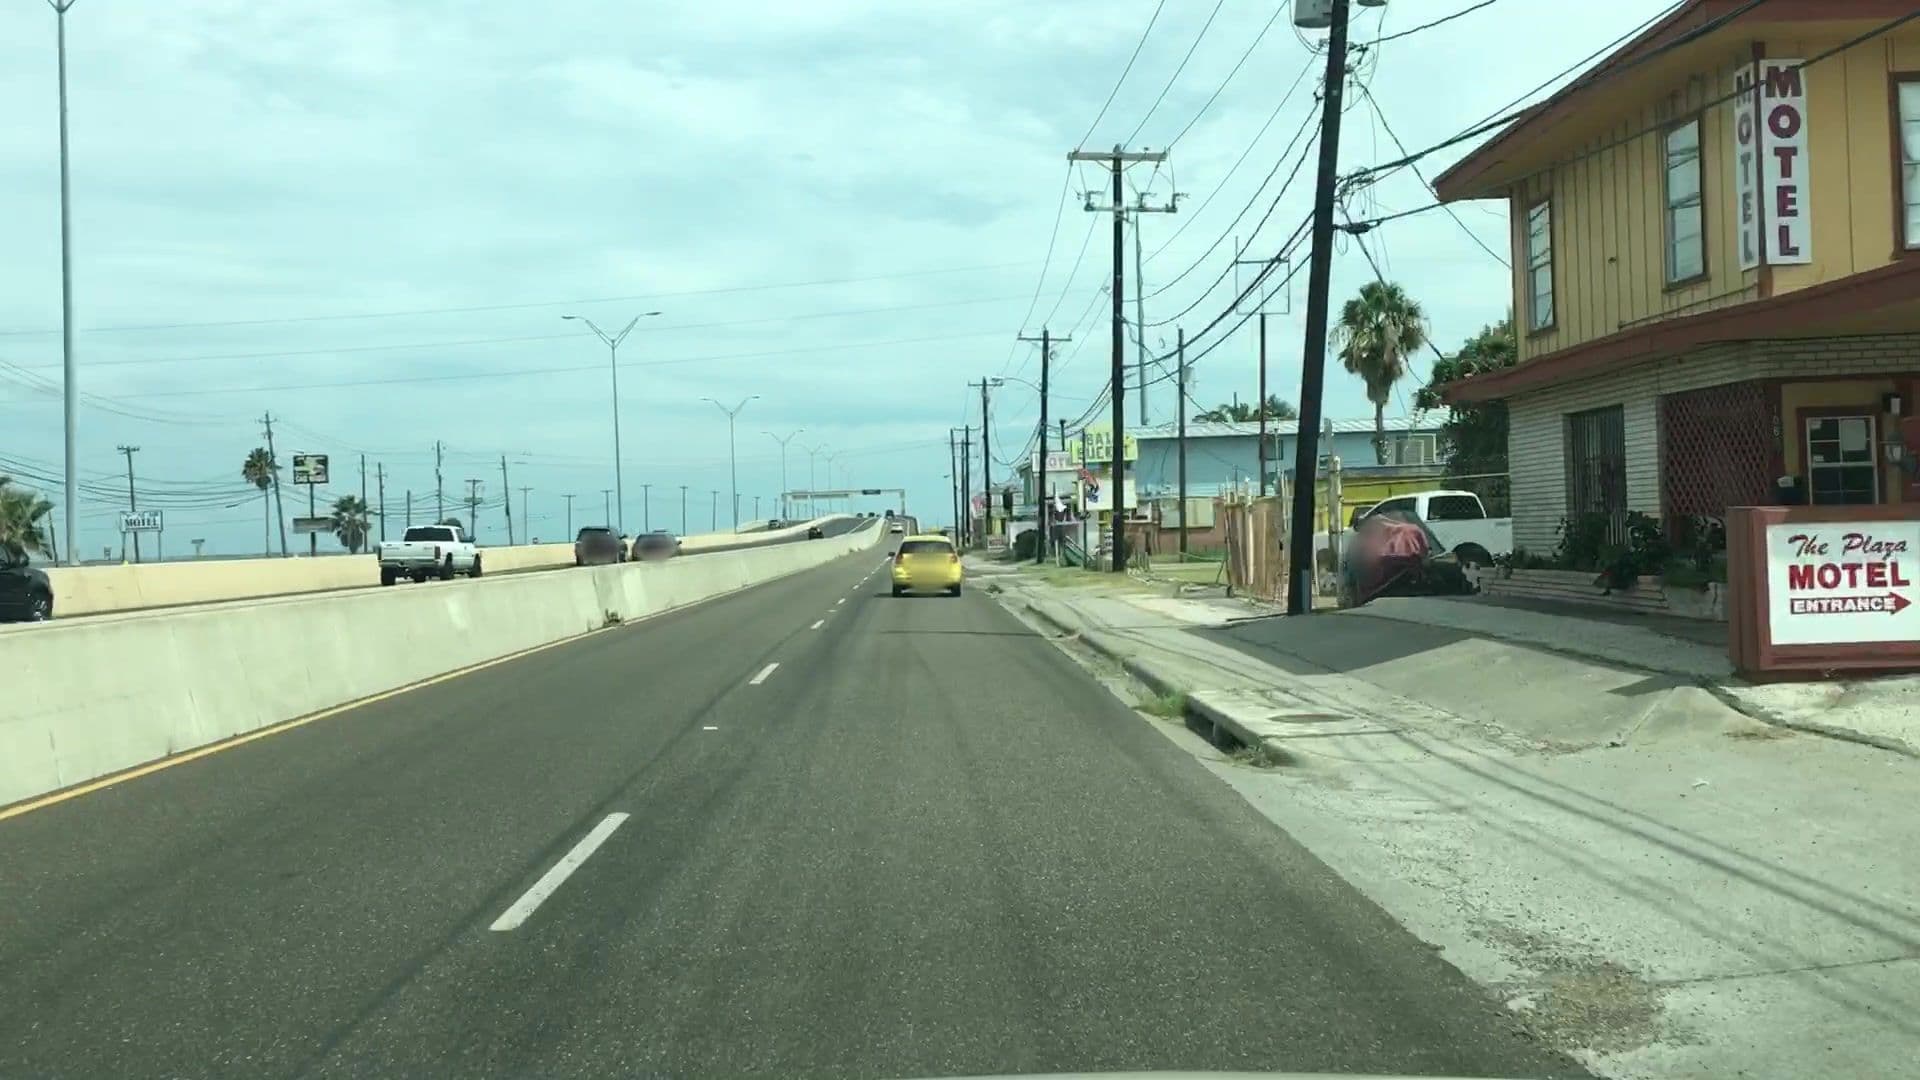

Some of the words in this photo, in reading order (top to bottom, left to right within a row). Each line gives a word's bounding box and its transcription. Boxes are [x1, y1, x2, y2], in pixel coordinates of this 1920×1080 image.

[1737, 70, 1753, 263] MOTEL
[1765, 66, 1802, 257] MOTEL
[1788, 535, 1828, 556] The
[1842, 533, 1907, 560] Plaza
[1789, 561, 1910, 590] MOTEL
[1793, 597, 1896, 613] ENTRANCE
